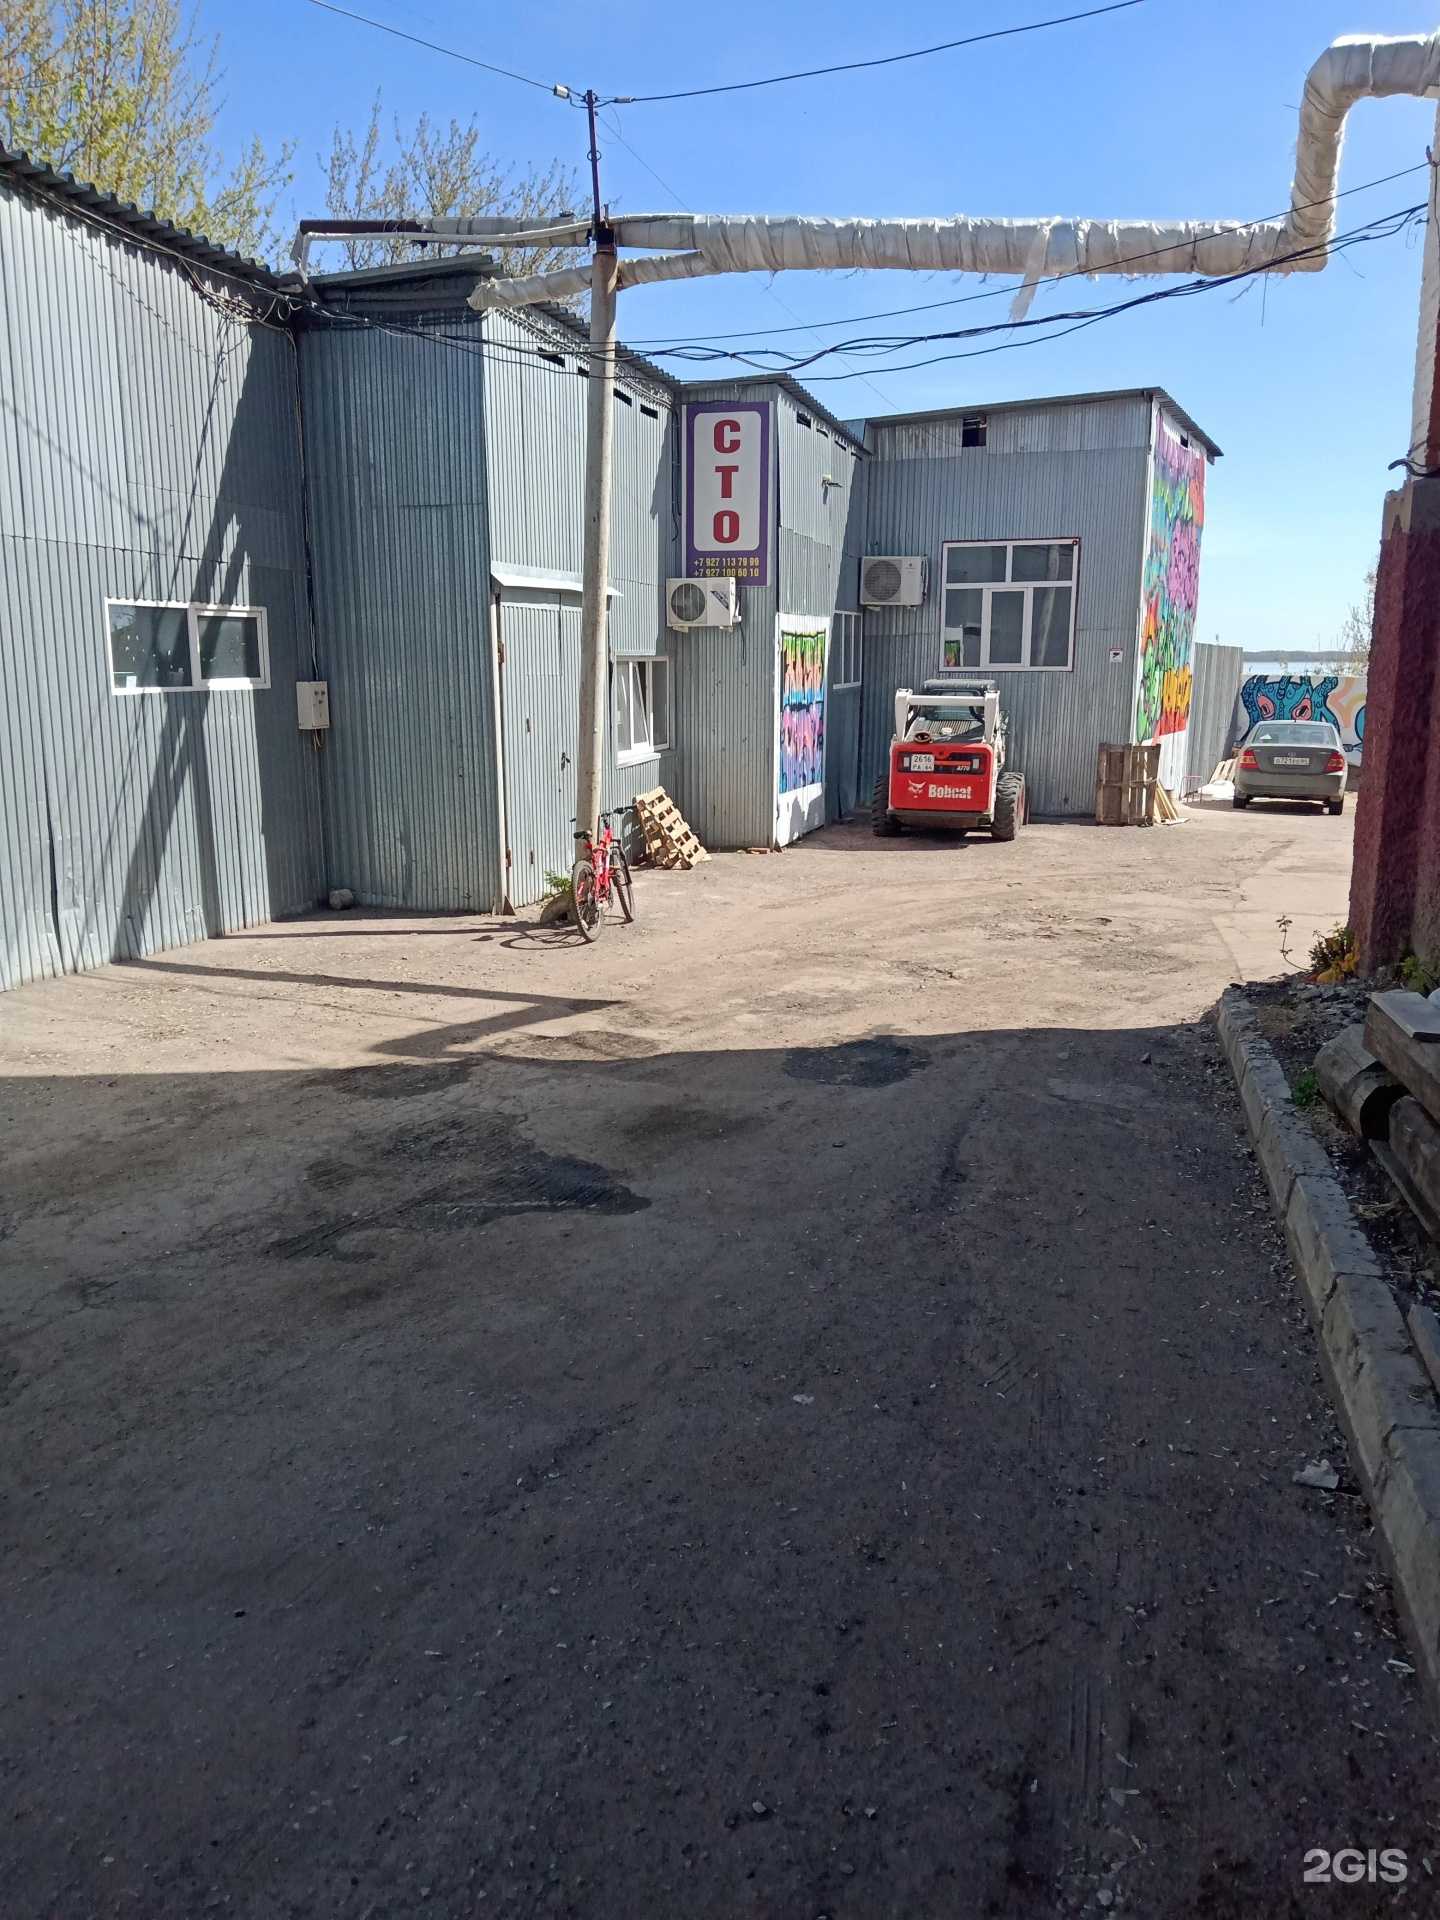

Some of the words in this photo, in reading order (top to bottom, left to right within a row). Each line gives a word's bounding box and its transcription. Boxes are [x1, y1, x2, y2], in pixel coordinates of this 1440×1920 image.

[713, 419, 741, 544] СТО
[694, 557, 704, 566] +7
[706, 557, 720, 566] 927
[694, 568, 704, 577] +7
[706, 568, 720, 577] 927
[928, 784, 972, 799] Bobcat
